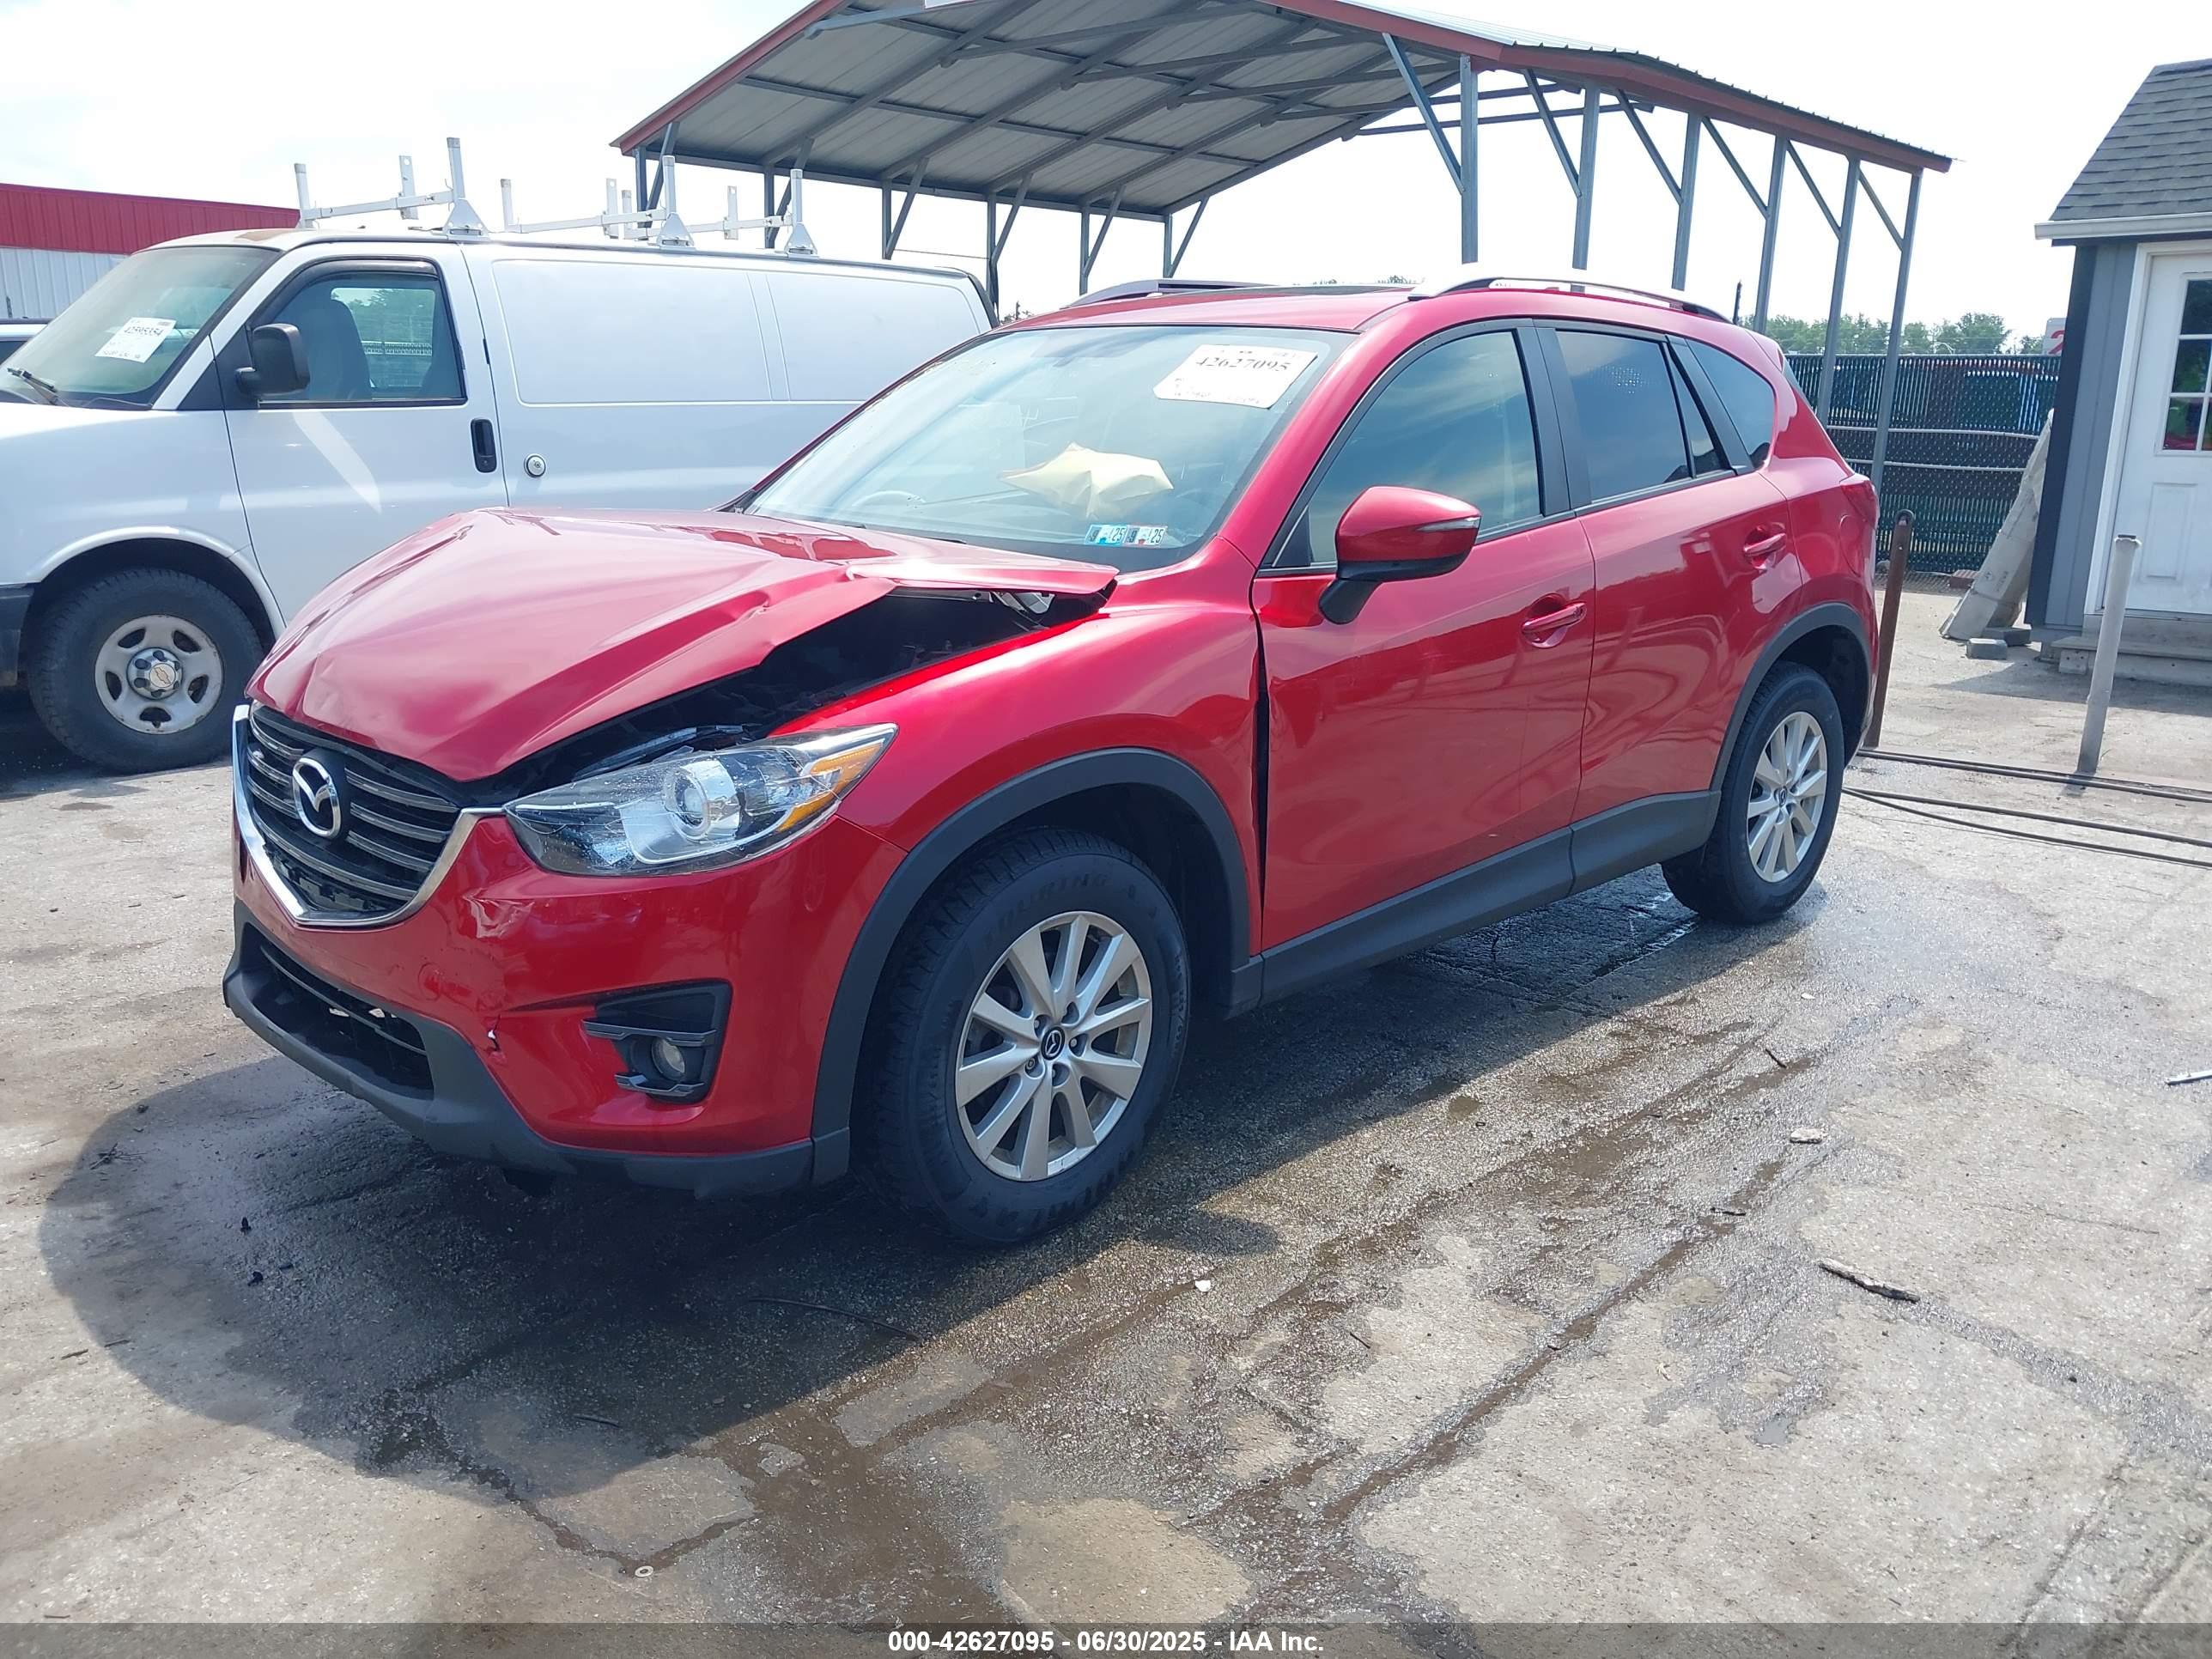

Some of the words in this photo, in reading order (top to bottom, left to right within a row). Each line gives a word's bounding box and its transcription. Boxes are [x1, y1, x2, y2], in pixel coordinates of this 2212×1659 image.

[1195, 356, 1291, 372] 42627095
[1111, 527, 1126, 542] 25
[1150, 528, 1164, 544] 25
